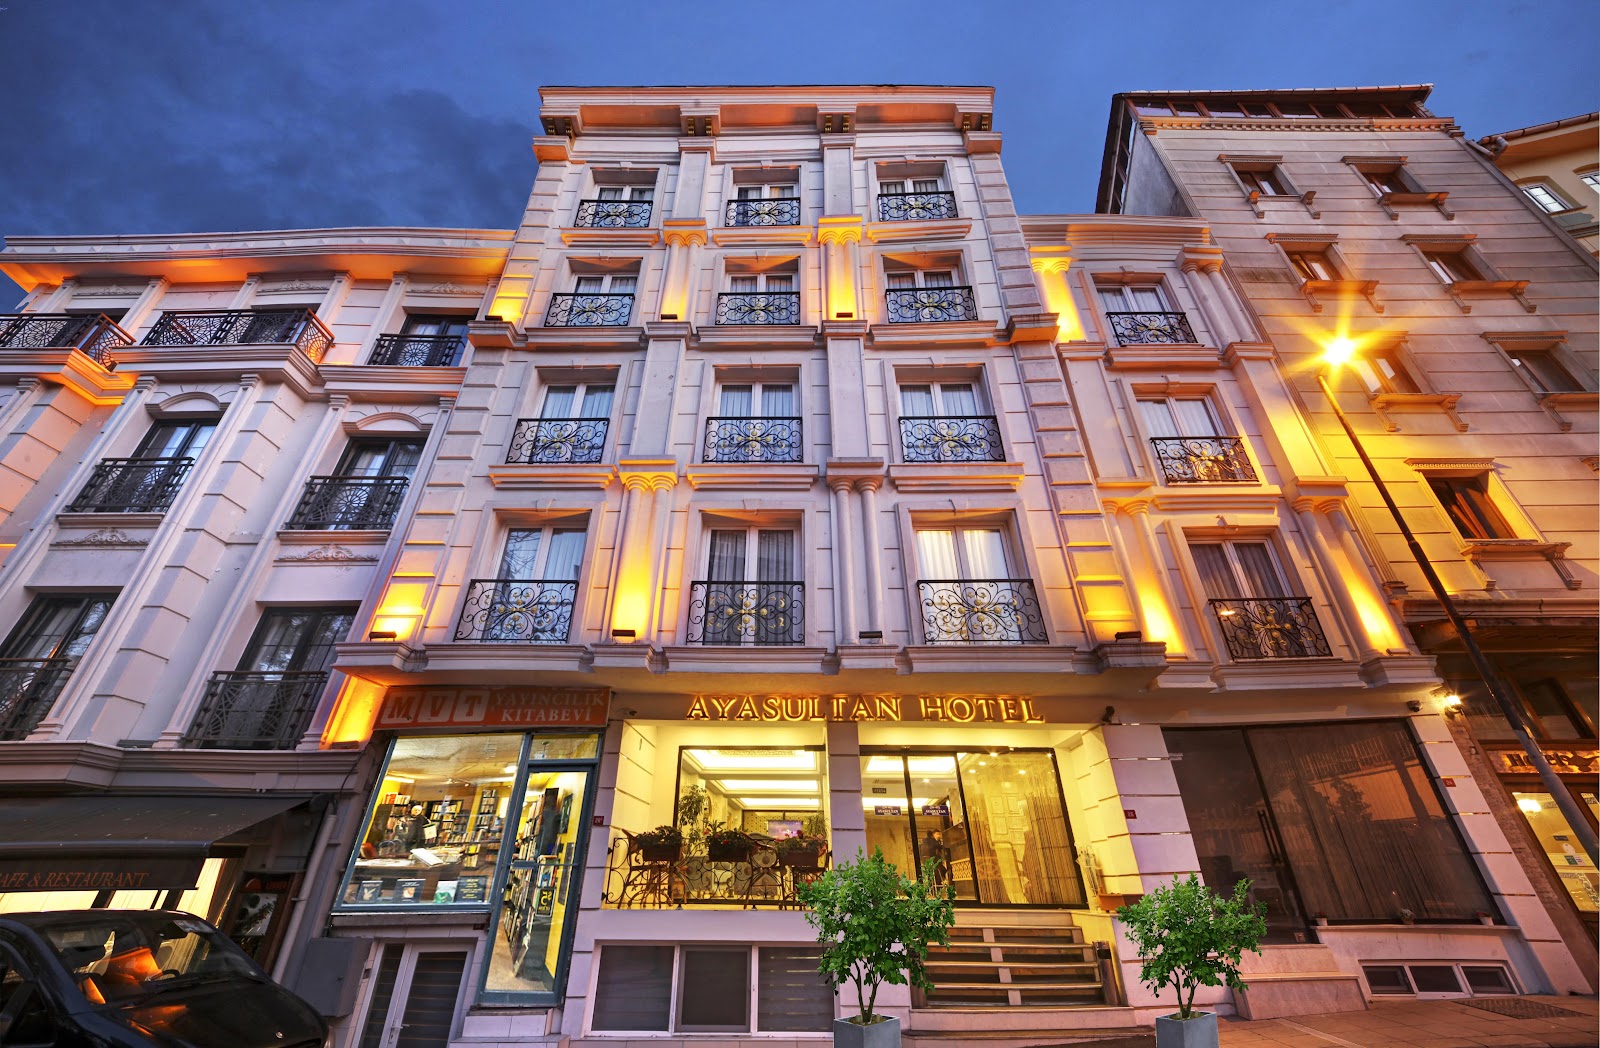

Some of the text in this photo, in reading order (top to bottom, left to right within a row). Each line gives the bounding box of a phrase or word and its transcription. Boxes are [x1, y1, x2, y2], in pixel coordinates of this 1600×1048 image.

[385, 693, 486, 720] MVT
[686, 695, 1045, 723] AYASULTAN HOTEL
[27, 873, 42, 887] &
[41, 872, 149, 887] RESTAURANT
